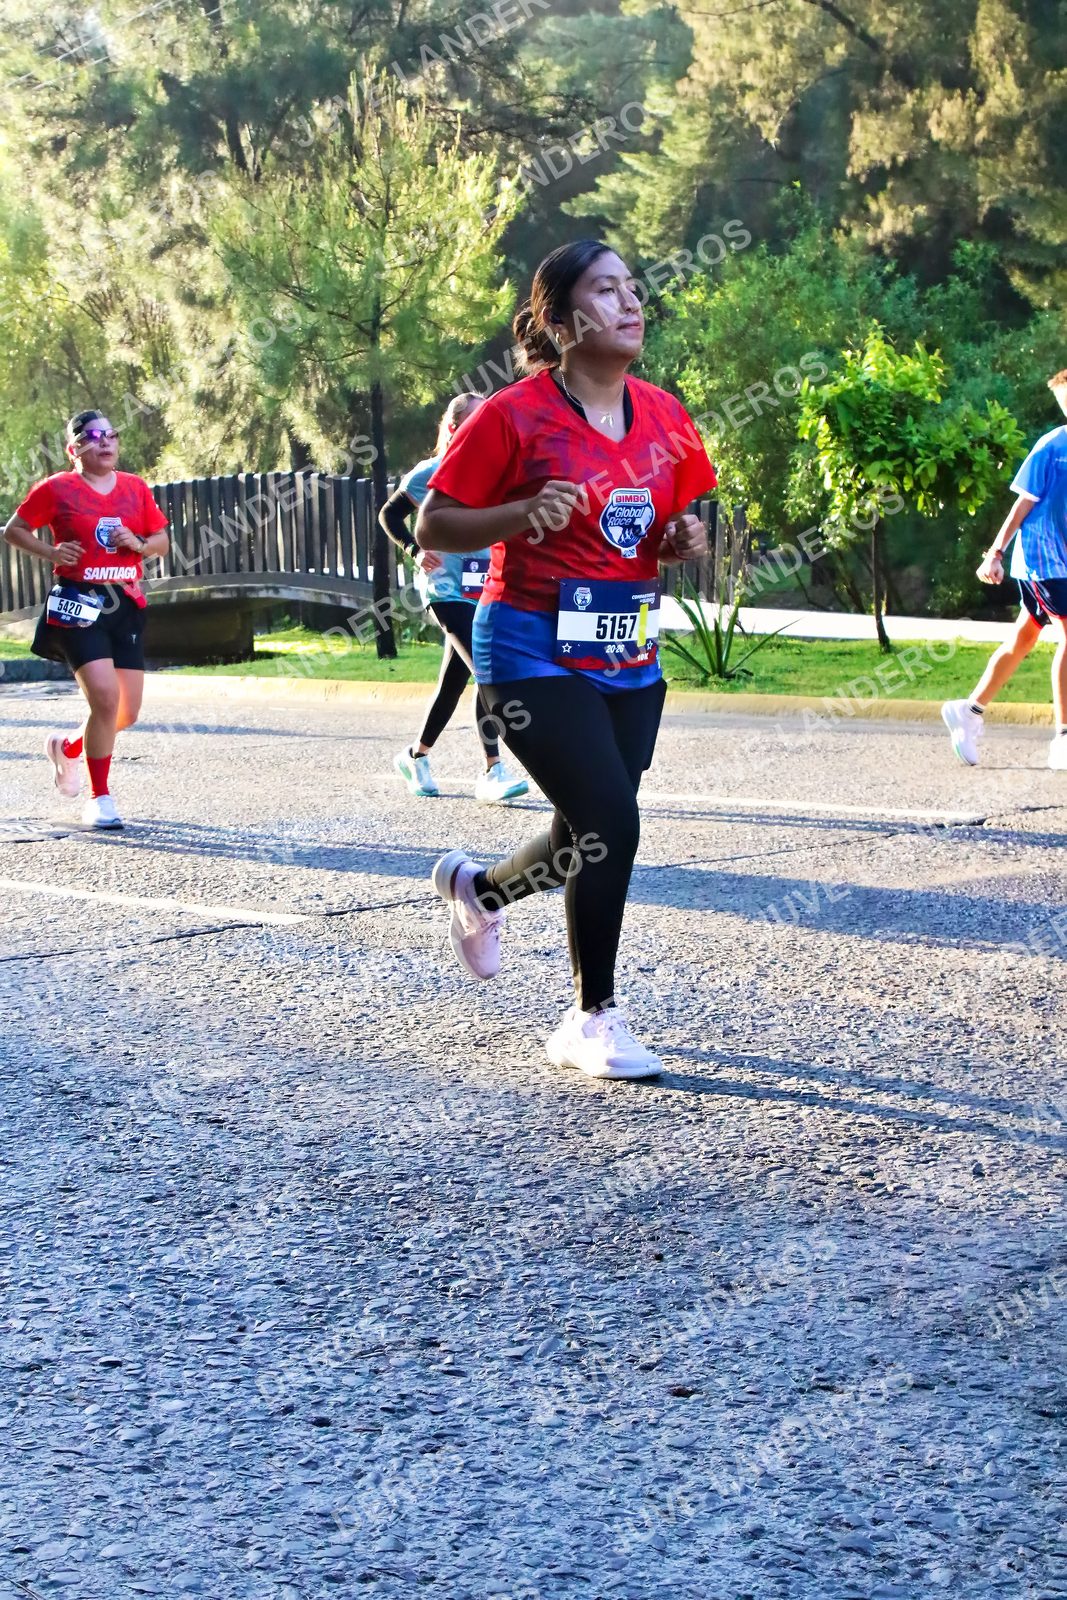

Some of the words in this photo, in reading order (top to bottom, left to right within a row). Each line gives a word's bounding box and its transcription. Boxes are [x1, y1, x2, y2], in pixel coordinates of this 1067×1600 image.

[615, 494, 646, 503] BIMBO
[614, 506, 645, 518] Global
[607, 516, 632, 527] Race
[83, 566, 137, 580] SANTIAGO
[57, 599, 83, 616] 5420
[595, 615, 638, 640] 5157
